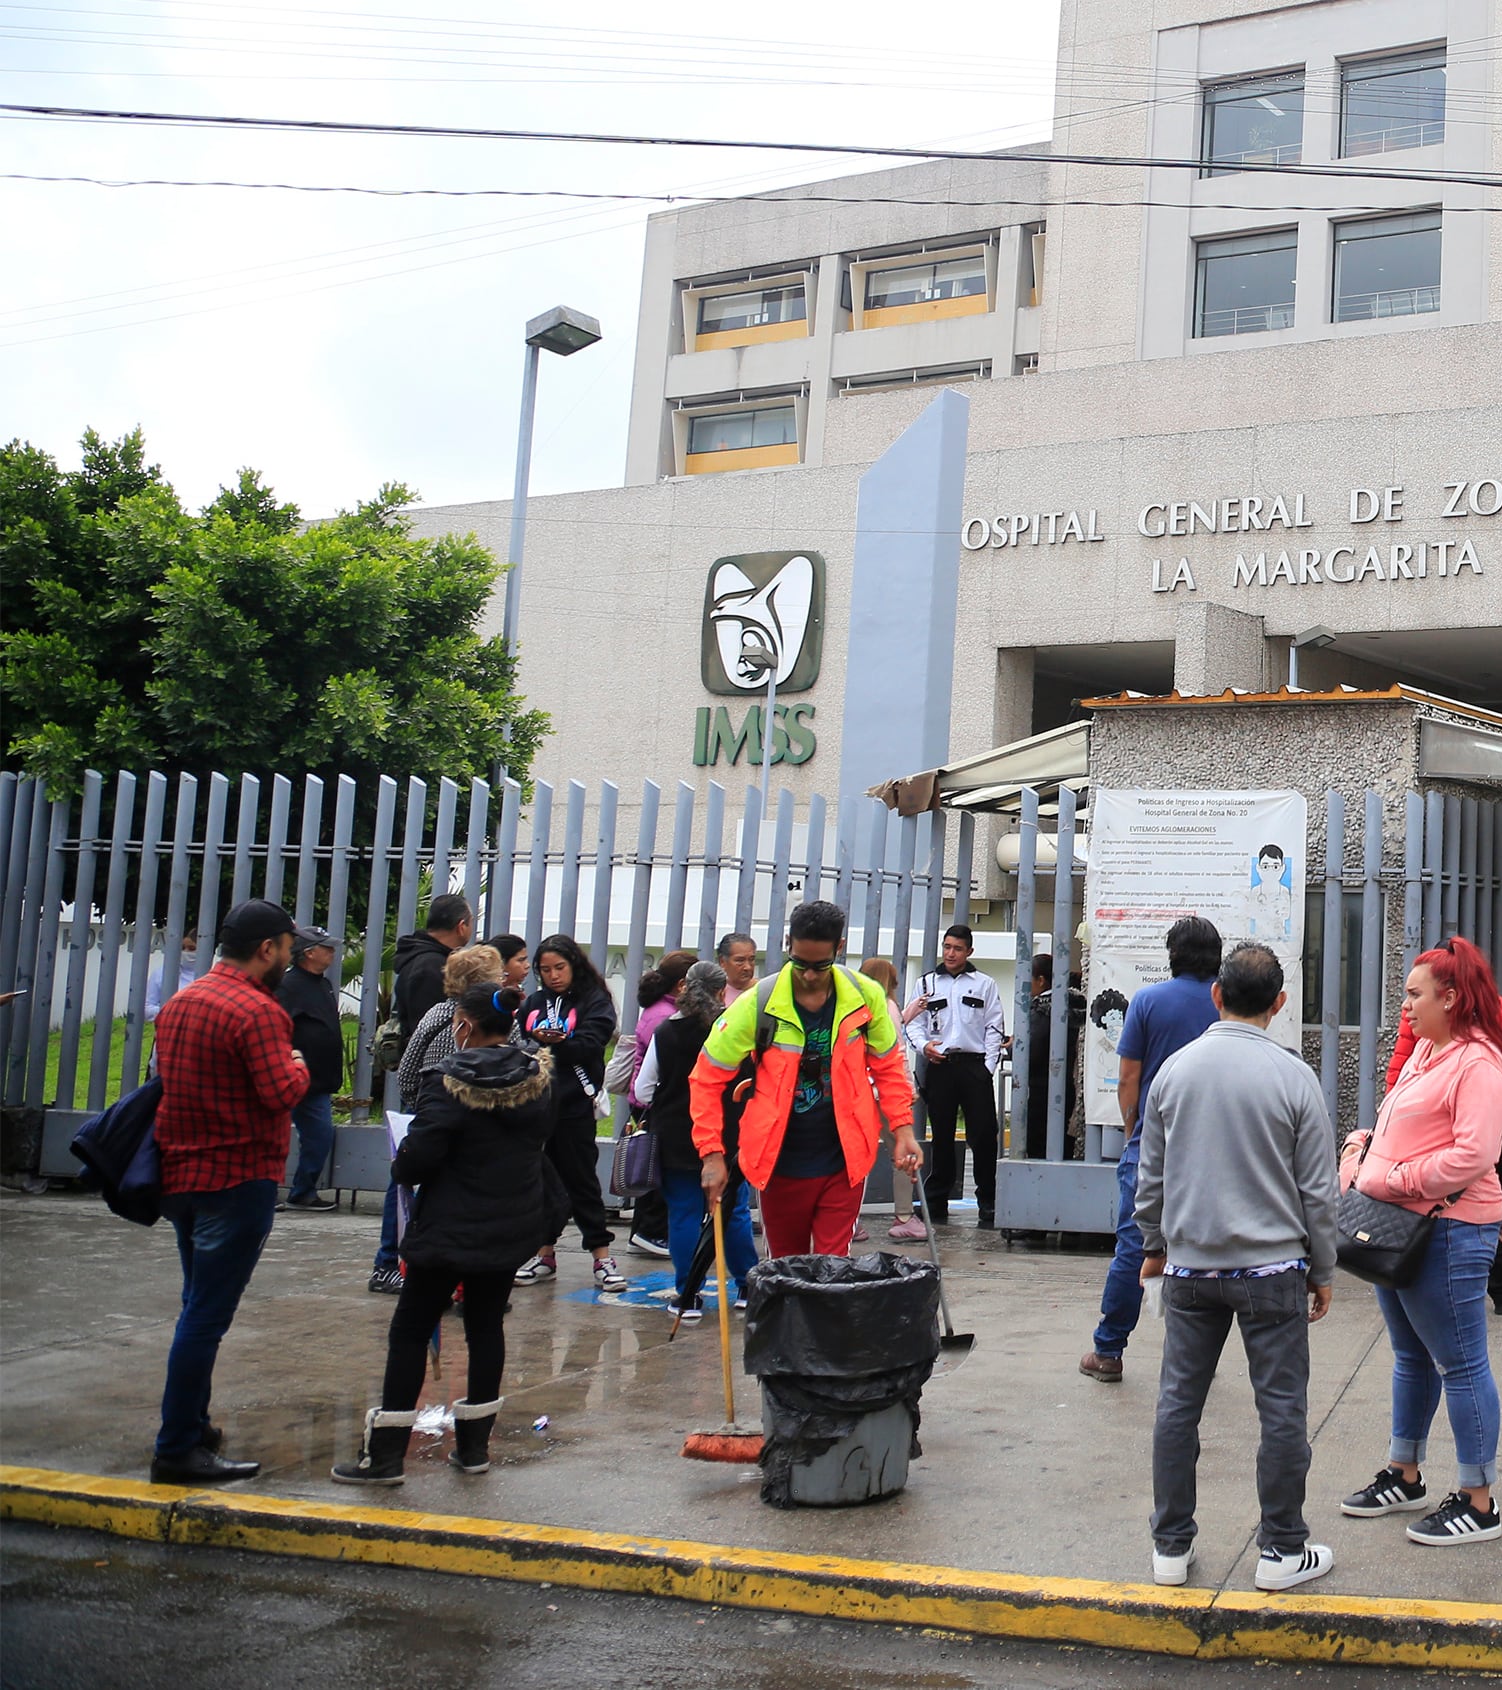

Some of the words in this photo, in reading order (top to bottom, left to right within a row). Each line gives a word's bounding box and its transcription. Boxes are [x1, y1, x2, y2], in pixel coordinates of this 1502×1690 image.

[961, 508, 1105, 551] OSPITAL
[1137, 494, 1313, 538] GENERAL
[1350, 487, 1404, 524] DE
[1151, 557, 1197, 593] LA
[1233, 539, 1483, 588] MARGARITA
[693, 703, 817, 766] IMSS
[1144, 809, 1171, 817] Hospital
[1165, 798, 1174, 806] de
[1175, 799, 1199, 807] Ingreso
[1129, 825, 1160, 833] EVITEMOS
